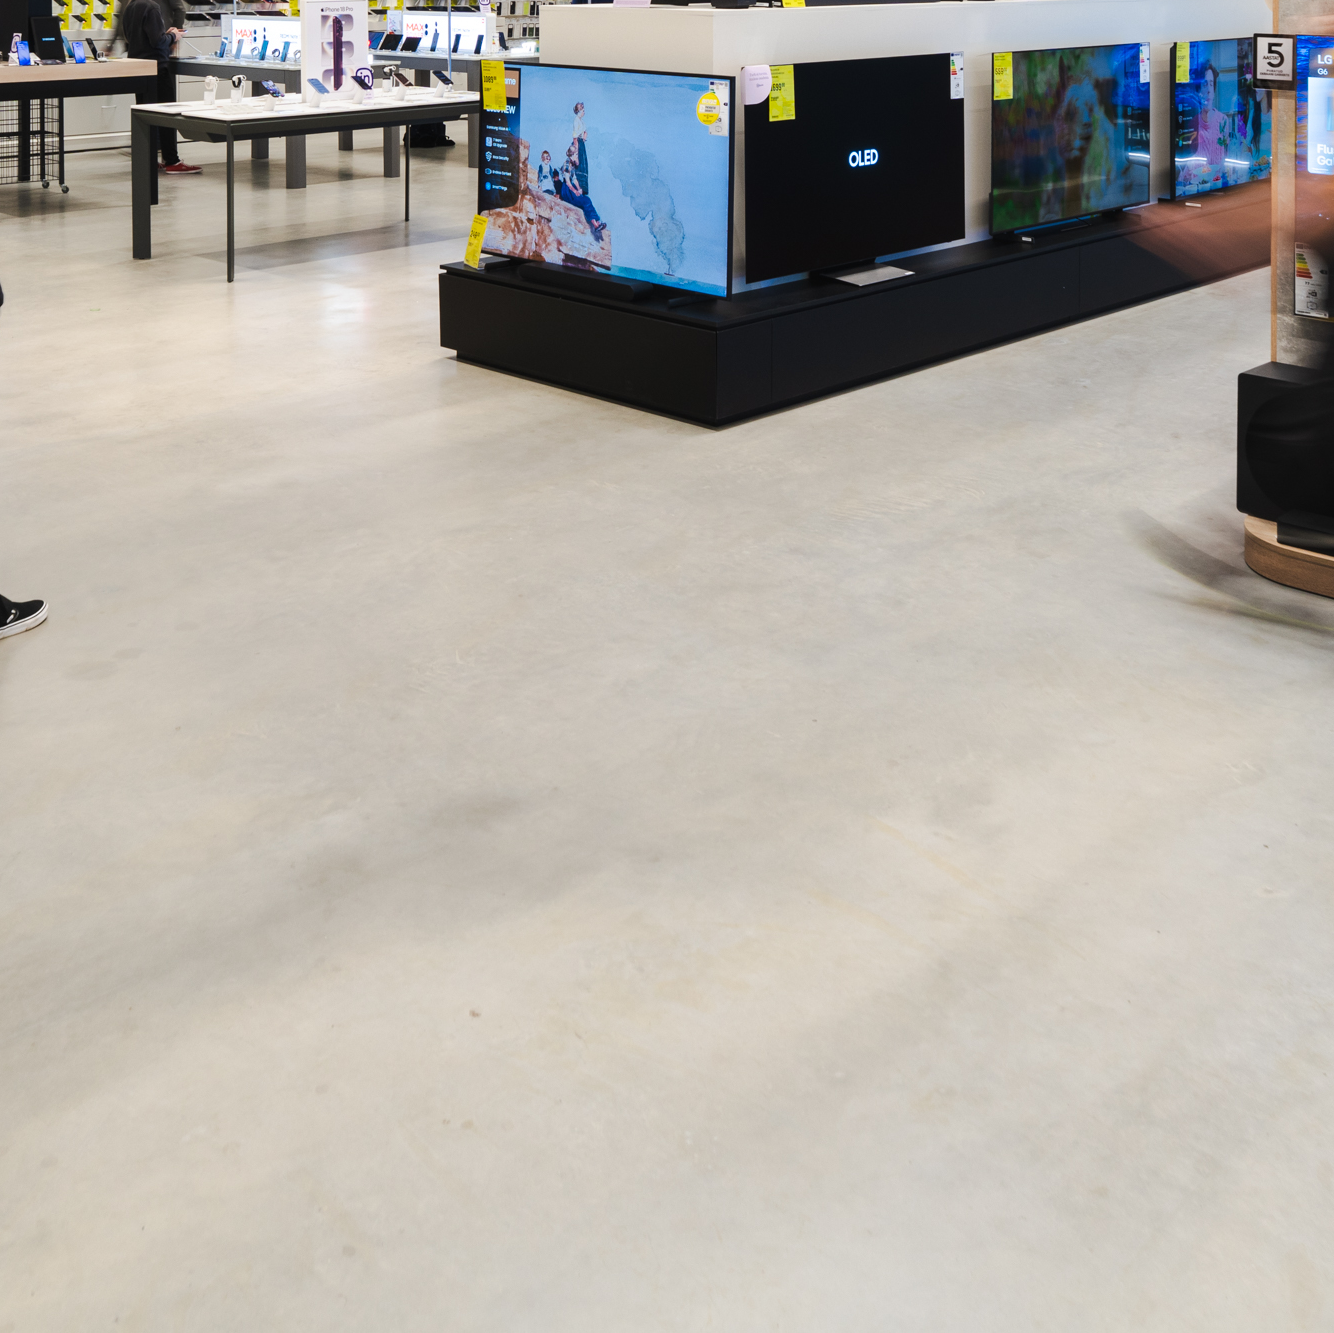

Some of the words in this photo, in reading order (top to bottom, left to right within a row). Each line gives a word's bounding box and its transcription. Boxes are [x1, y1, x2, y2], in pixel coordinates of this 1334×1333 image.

[406, 23, 424, 32] MAX
[235, 29, 252, 38] MAX
[1267, 43, 1284, 68] 5
[1318, 55, 1332, 64] LG
[849, 149, 878, 167] OLED
